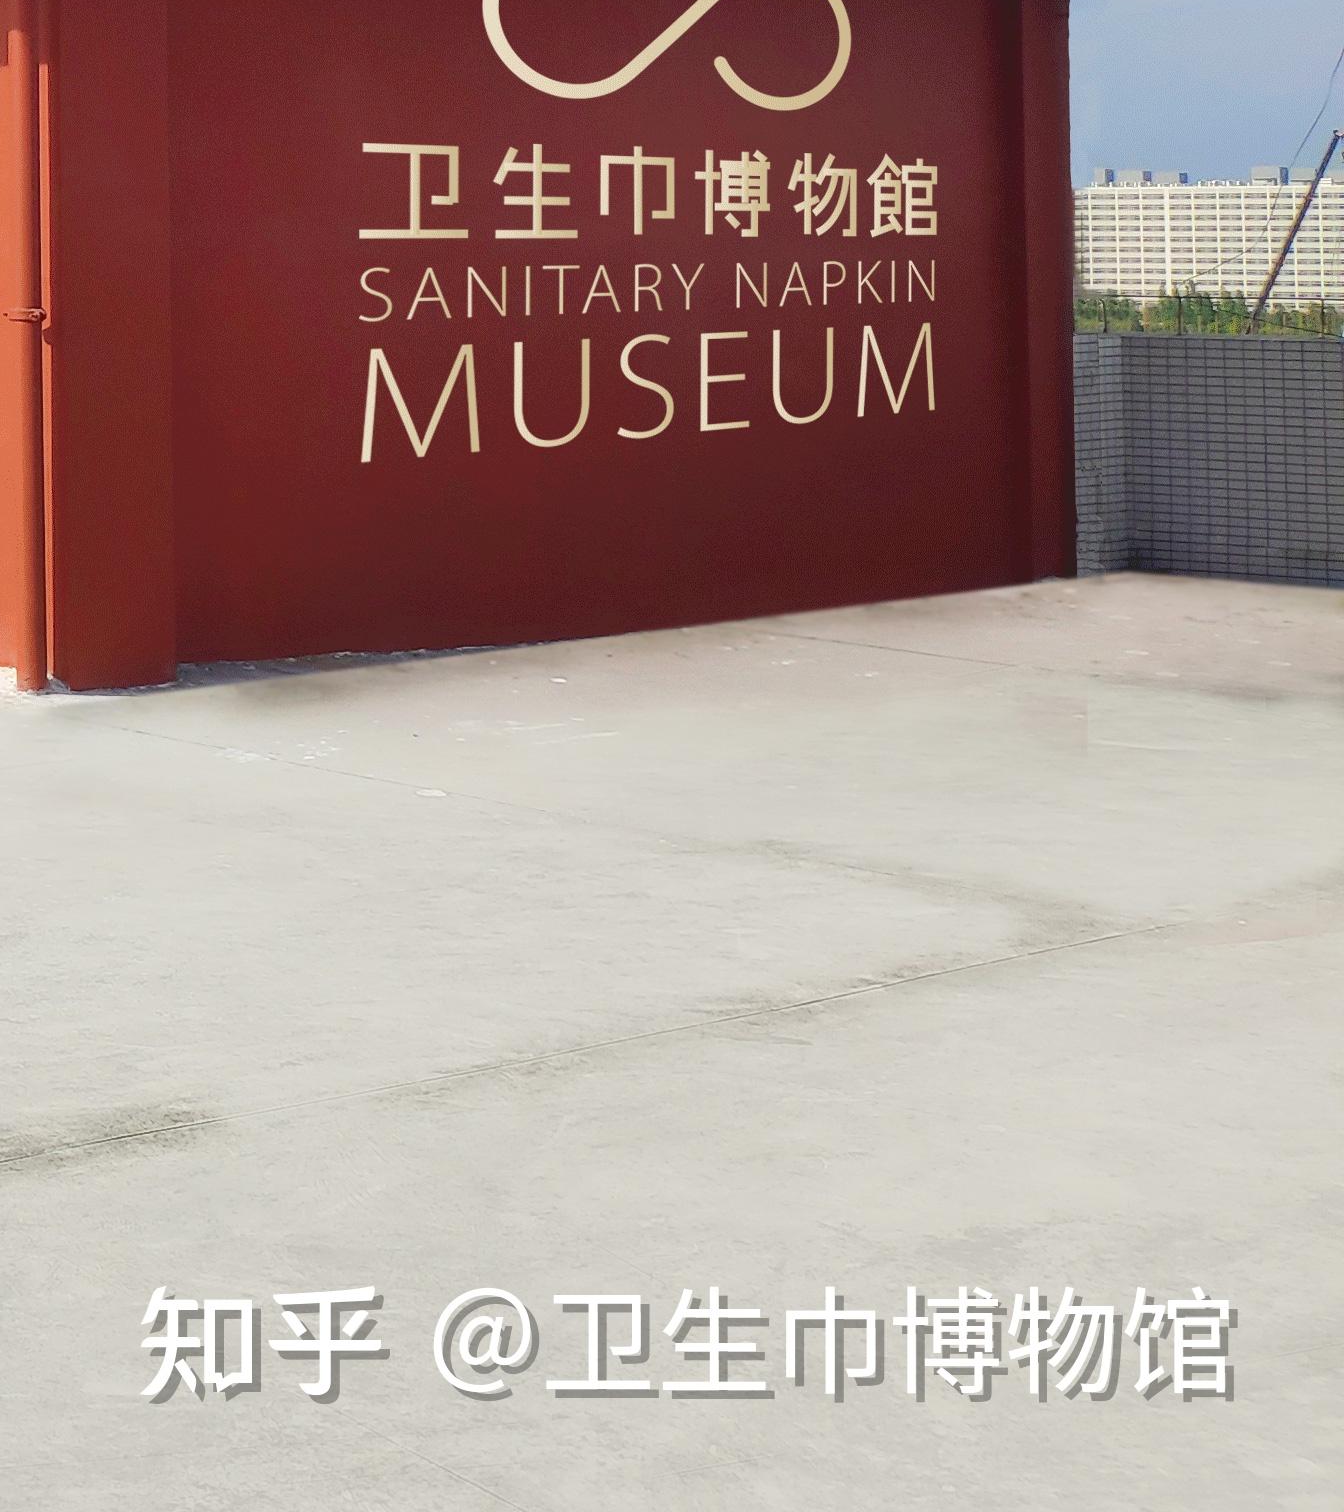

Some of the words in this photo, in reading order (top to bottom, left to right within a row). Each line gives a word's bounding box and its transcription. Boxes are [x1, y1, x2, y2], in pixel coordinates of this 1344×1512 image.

[359, 142, 939, 239] 卫生巾博物館
[358, 263, 705, 323] SANITARY
[736, 259, 936, 309] NAPKIN
[360, 322, 936, 464] MUSEUM
